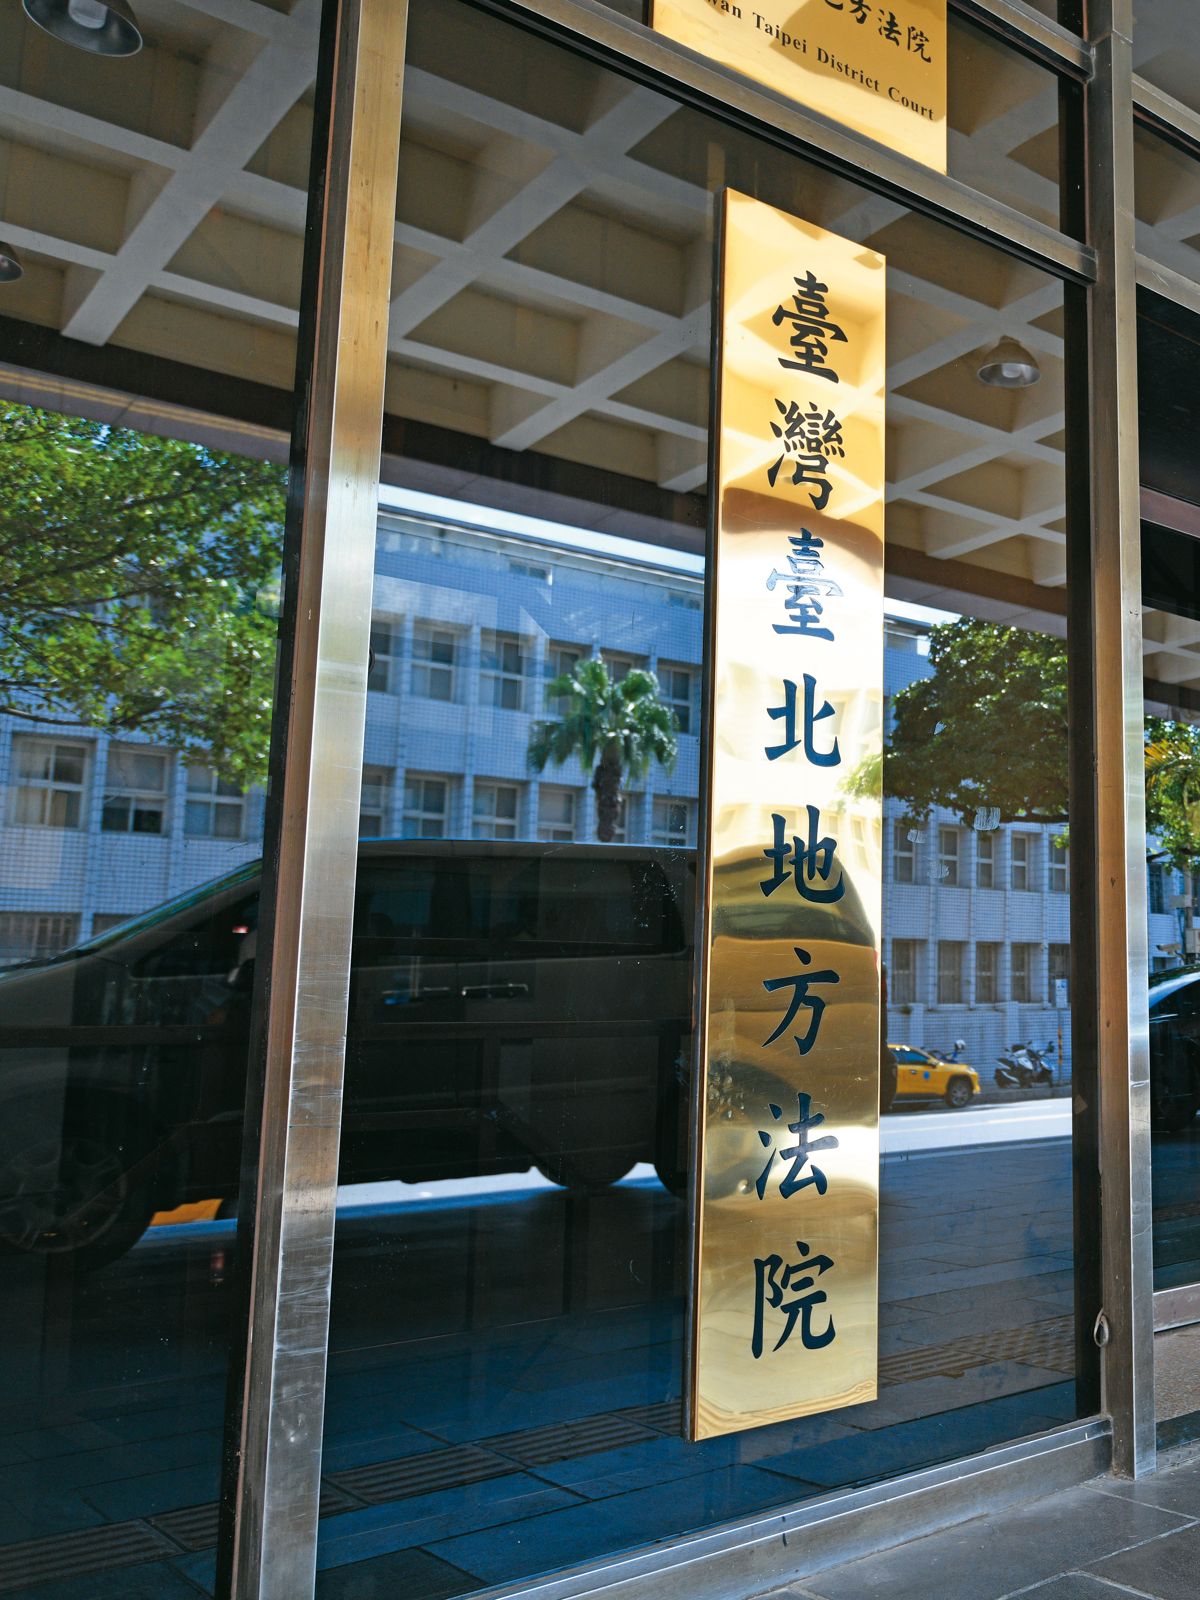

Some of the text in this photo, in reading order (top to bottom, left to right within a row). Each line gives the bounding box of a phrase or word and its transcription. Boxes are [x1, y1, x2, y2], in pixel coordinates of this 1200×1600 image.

[752, 12, 807, 54] Taipei
[817, 47, 880, 92] District
[888, 86, 935, 121] Court
[825, 0, 932, 63] 方法院
[751, 270, 849, 1359] 臺灣臺北地方法院
